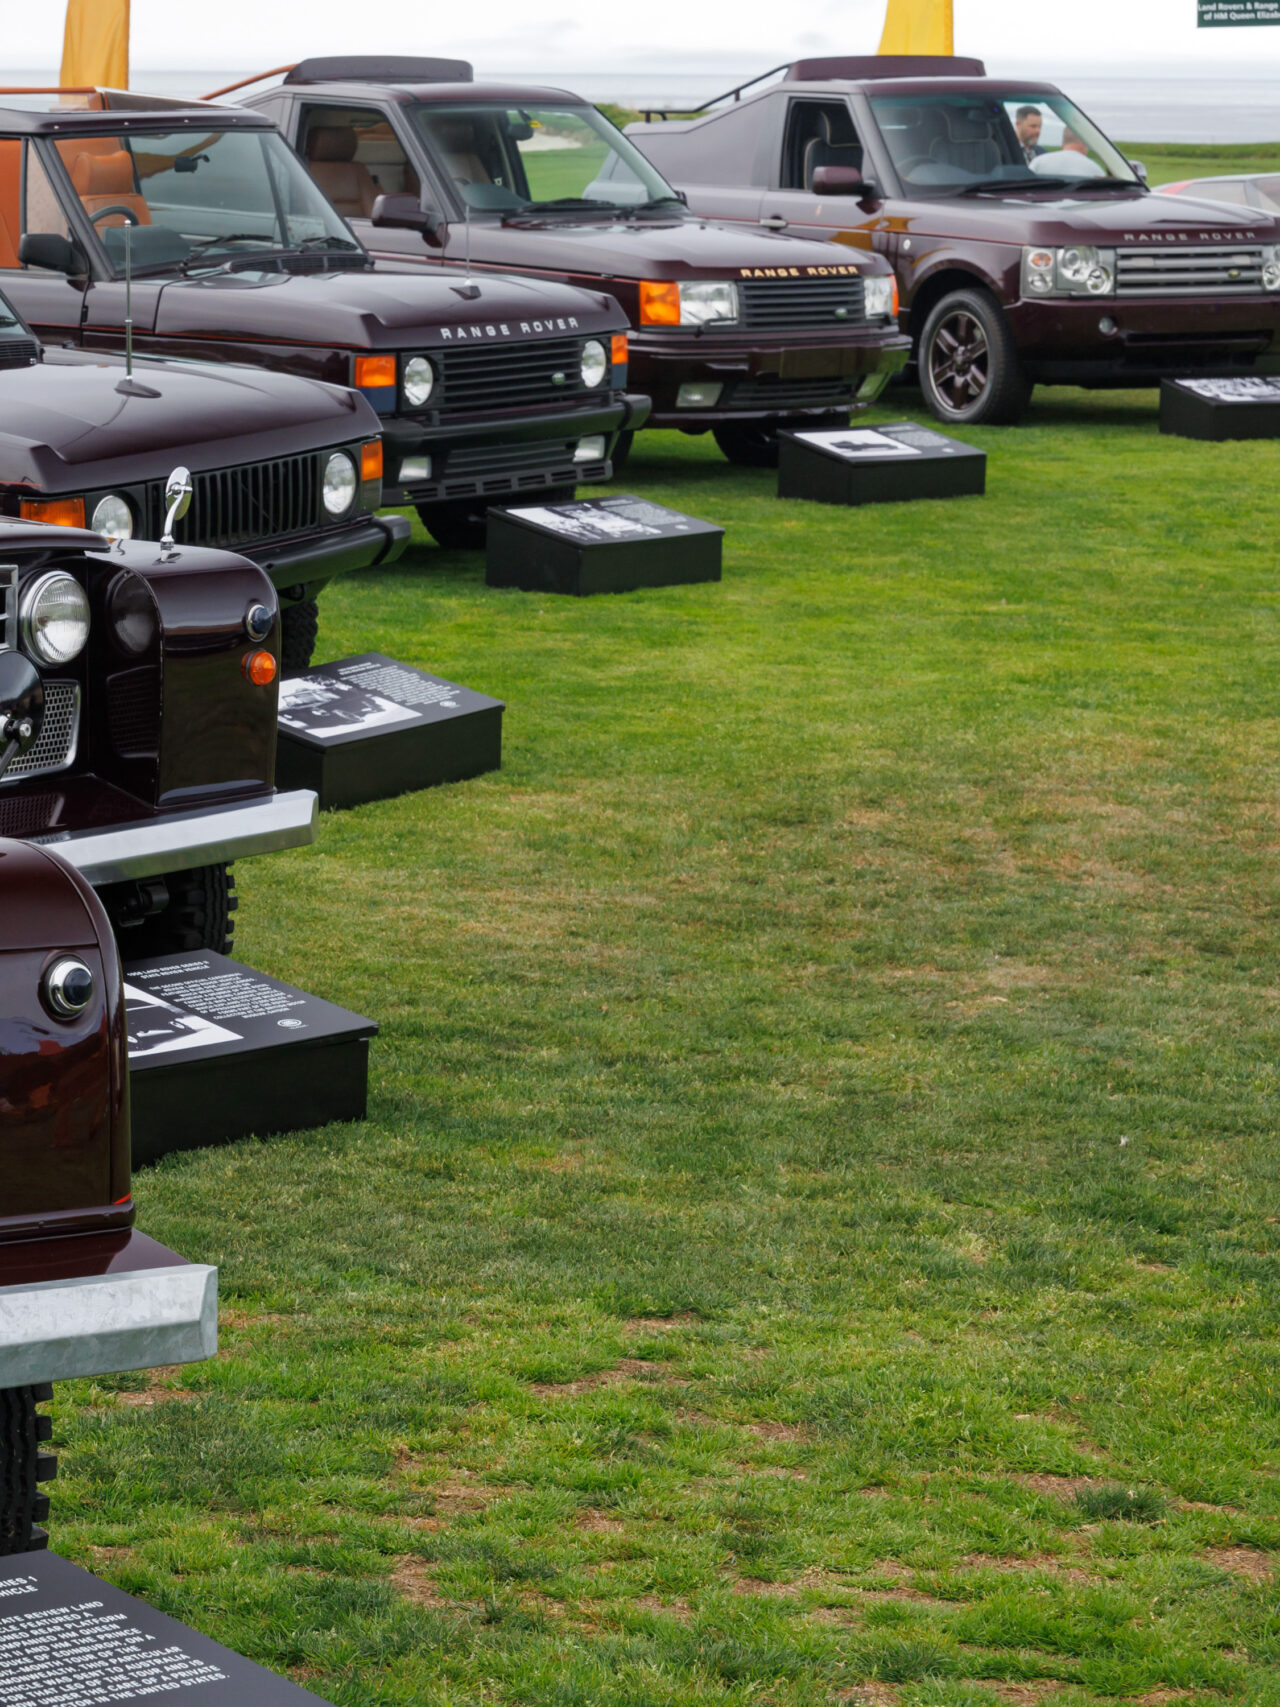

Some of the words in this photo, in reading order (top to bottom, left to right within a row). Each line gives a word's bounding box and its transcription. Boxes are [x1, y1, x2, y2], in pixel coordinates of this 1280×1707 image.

[1254, 2, 1278, 10] Range
[1203, 12, 1212, 20] of
[1229, 12, 1255, 20] Queen
[1123, 233, 1188, 241] RANGE
[1199, 232, 1256, 240] ROVER
[740, 267, 800, 278] RANGE
[806, 265, 858, 276] ROVER
[440, 324, 510, 339] RANGE
[520, 317, 579, 334] ROVER
[24, 1607, 69, 1619] REVIEW
[70, 1601, 103, 1610] LAND
[19, 1613, 80, 1628] FEATURED
[30, 1625, 63, 1635] REAR
[64, 1613, 126, 1628] PLATFORM
[79, 1623, 119, 1634] QUEEN
[24, 1645, 49, 1653] AND
[70, 1636, 96, 1644] THE
[96, 1628, 141, 1639] PRINCE
[62, 1654, 97, 1663] TOUR
[114, 1645, 140, 1653] THE
[78, 1660, 108, 1669] THIS
[109, 1646, 181, 1663] PARTICULAR
[43, 1676, 72, 1685] WAS
[72, 1669, 104, 1679] SENT
[125, 1654, 189, 1669] AUSTRALIA
[0, 1693, 26, 1702] FOR
[26, 1687, 57, 1697] THAT
[59, 1682, 84, 1691] LEG
[85, 1678, 101, 1686] OF
[102, 1674, 129, 1682] THE
[128, 1667, 162, 1677] TOUR
[163, 1662, 188, 1671] AND
[37, 1692, 80, 1704] UNDER
[80, 1687, 107, 1695] THE
[107, 1680, 141, 1690] CARE
[170, 1665, 219, 1678] PRIVATE
[109, 1690, 135, 1699] THE
[135, 1682, 179, 1694] UNITED
